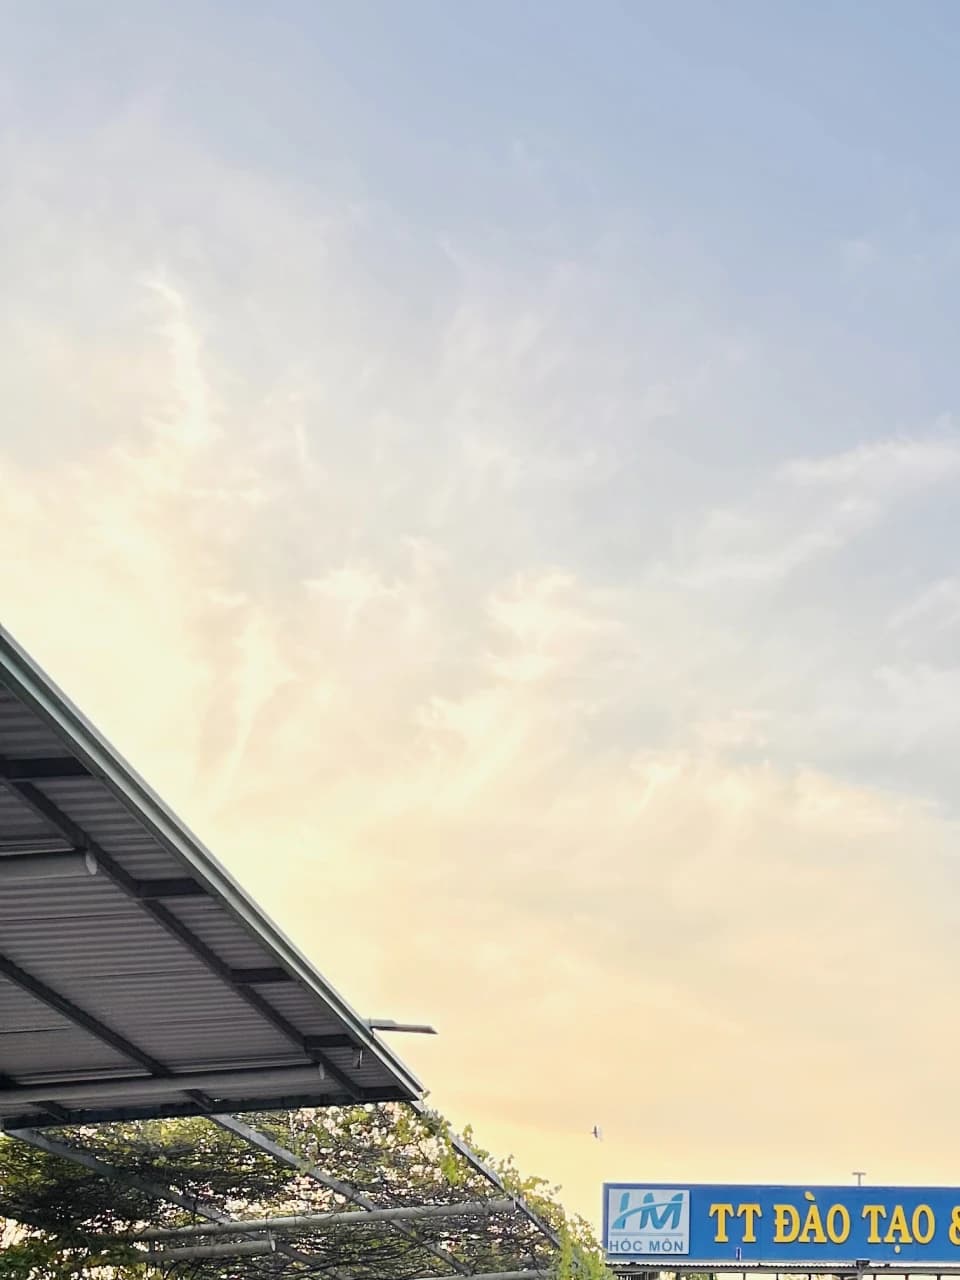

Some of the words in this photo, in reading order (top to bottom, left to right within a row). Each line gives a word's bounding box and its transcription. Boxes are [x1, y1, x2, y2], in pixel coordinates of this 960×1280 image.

[709, 1203, 762, 1243] TT
[773, 1191, 851, 1244] ĐÀO
[862, 1204, 936, 1254] TẠO
[609, 1238, 643, 1252] HÓC
[649, 1238, 684, 1252] MÔN
